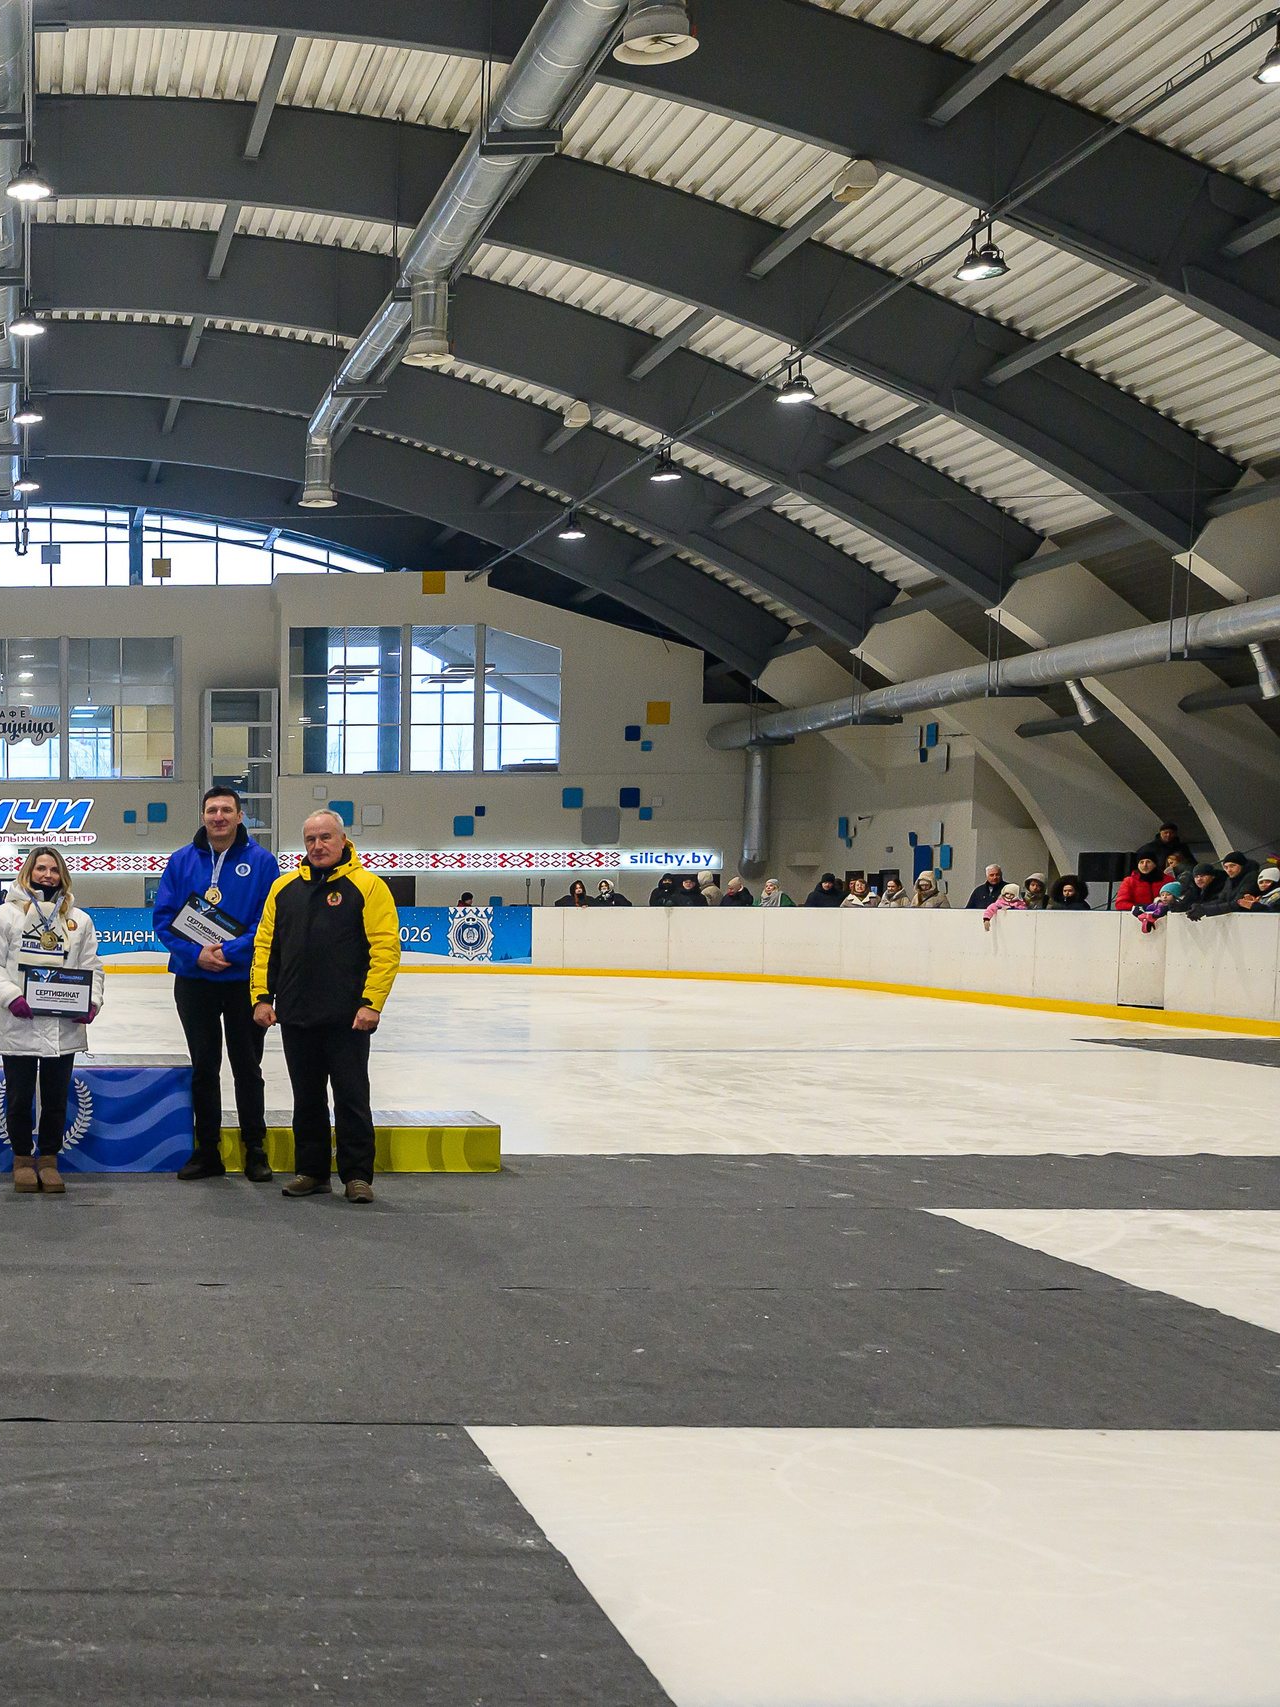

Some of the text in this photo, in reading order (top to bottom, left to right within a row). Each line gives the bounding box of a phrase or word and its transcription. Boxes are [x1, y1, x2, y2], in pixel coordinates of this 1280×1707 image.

[59, 834, 95, 845] ЦЕНТР
[629, 852, 713, 867] silichy.by
[95, 930, 161, 946] езиден
[399, 926, 432, 943] 026
[35, 989, 80, 999] СЕРТИФИКАТ
